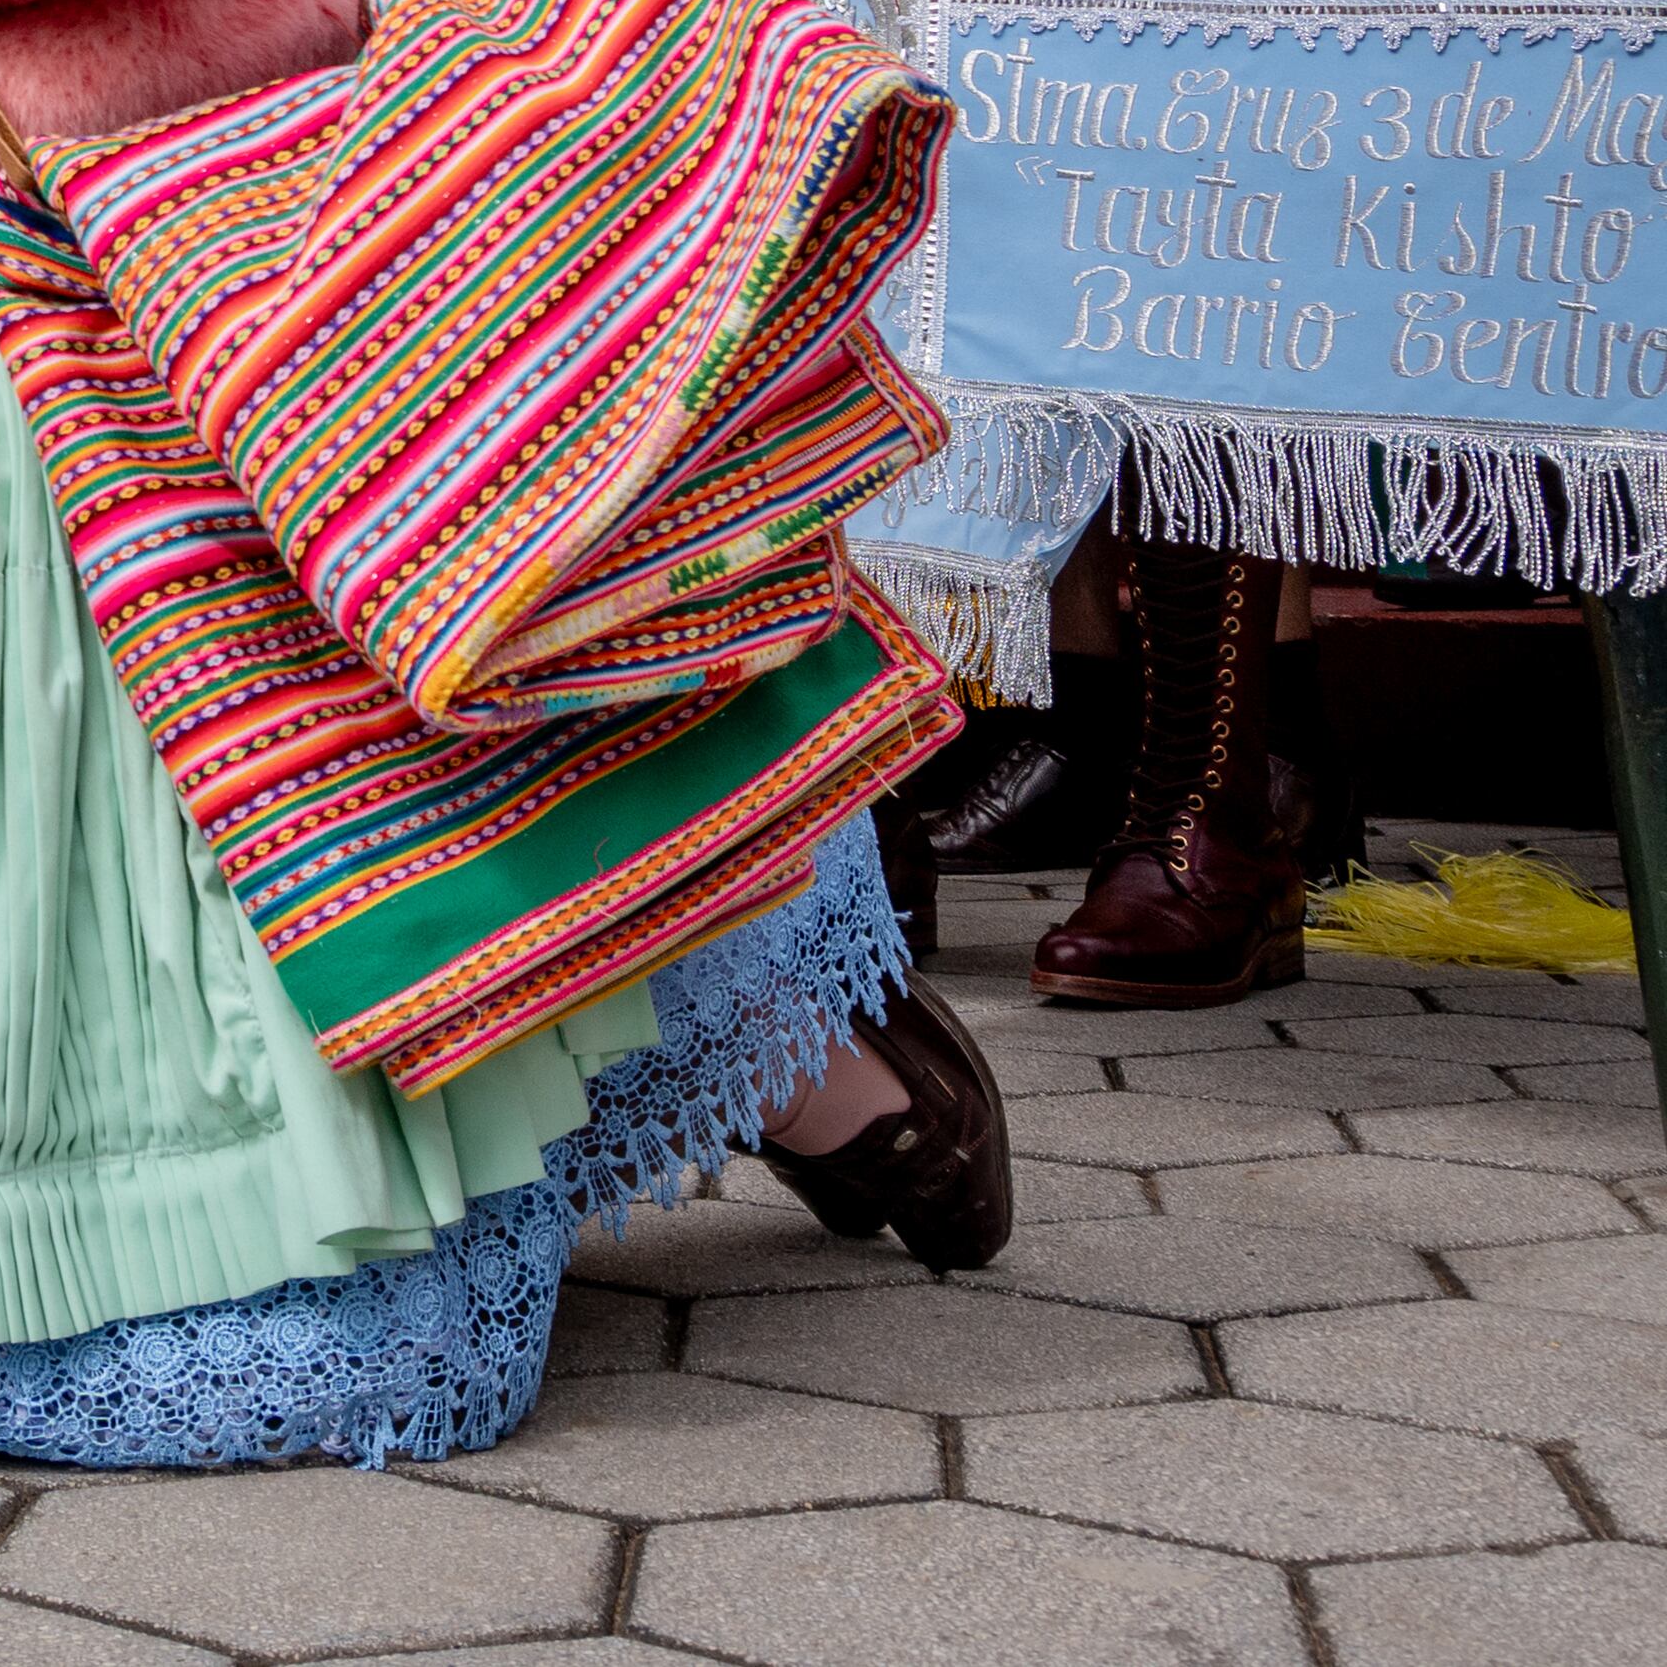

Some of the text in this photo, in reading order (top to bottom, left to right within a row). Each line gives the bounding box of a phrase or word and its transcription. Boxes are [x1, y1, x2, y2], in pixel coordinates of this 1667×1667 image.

[955, 37, 1148, 147] Stma.
[1155, 67, 1344, 172] Cruz
[1358, 85, 1414, 162] 3
[1425, 60, 1516, 160] de
[1060, 264, 1667, 400] Barrio Centro
